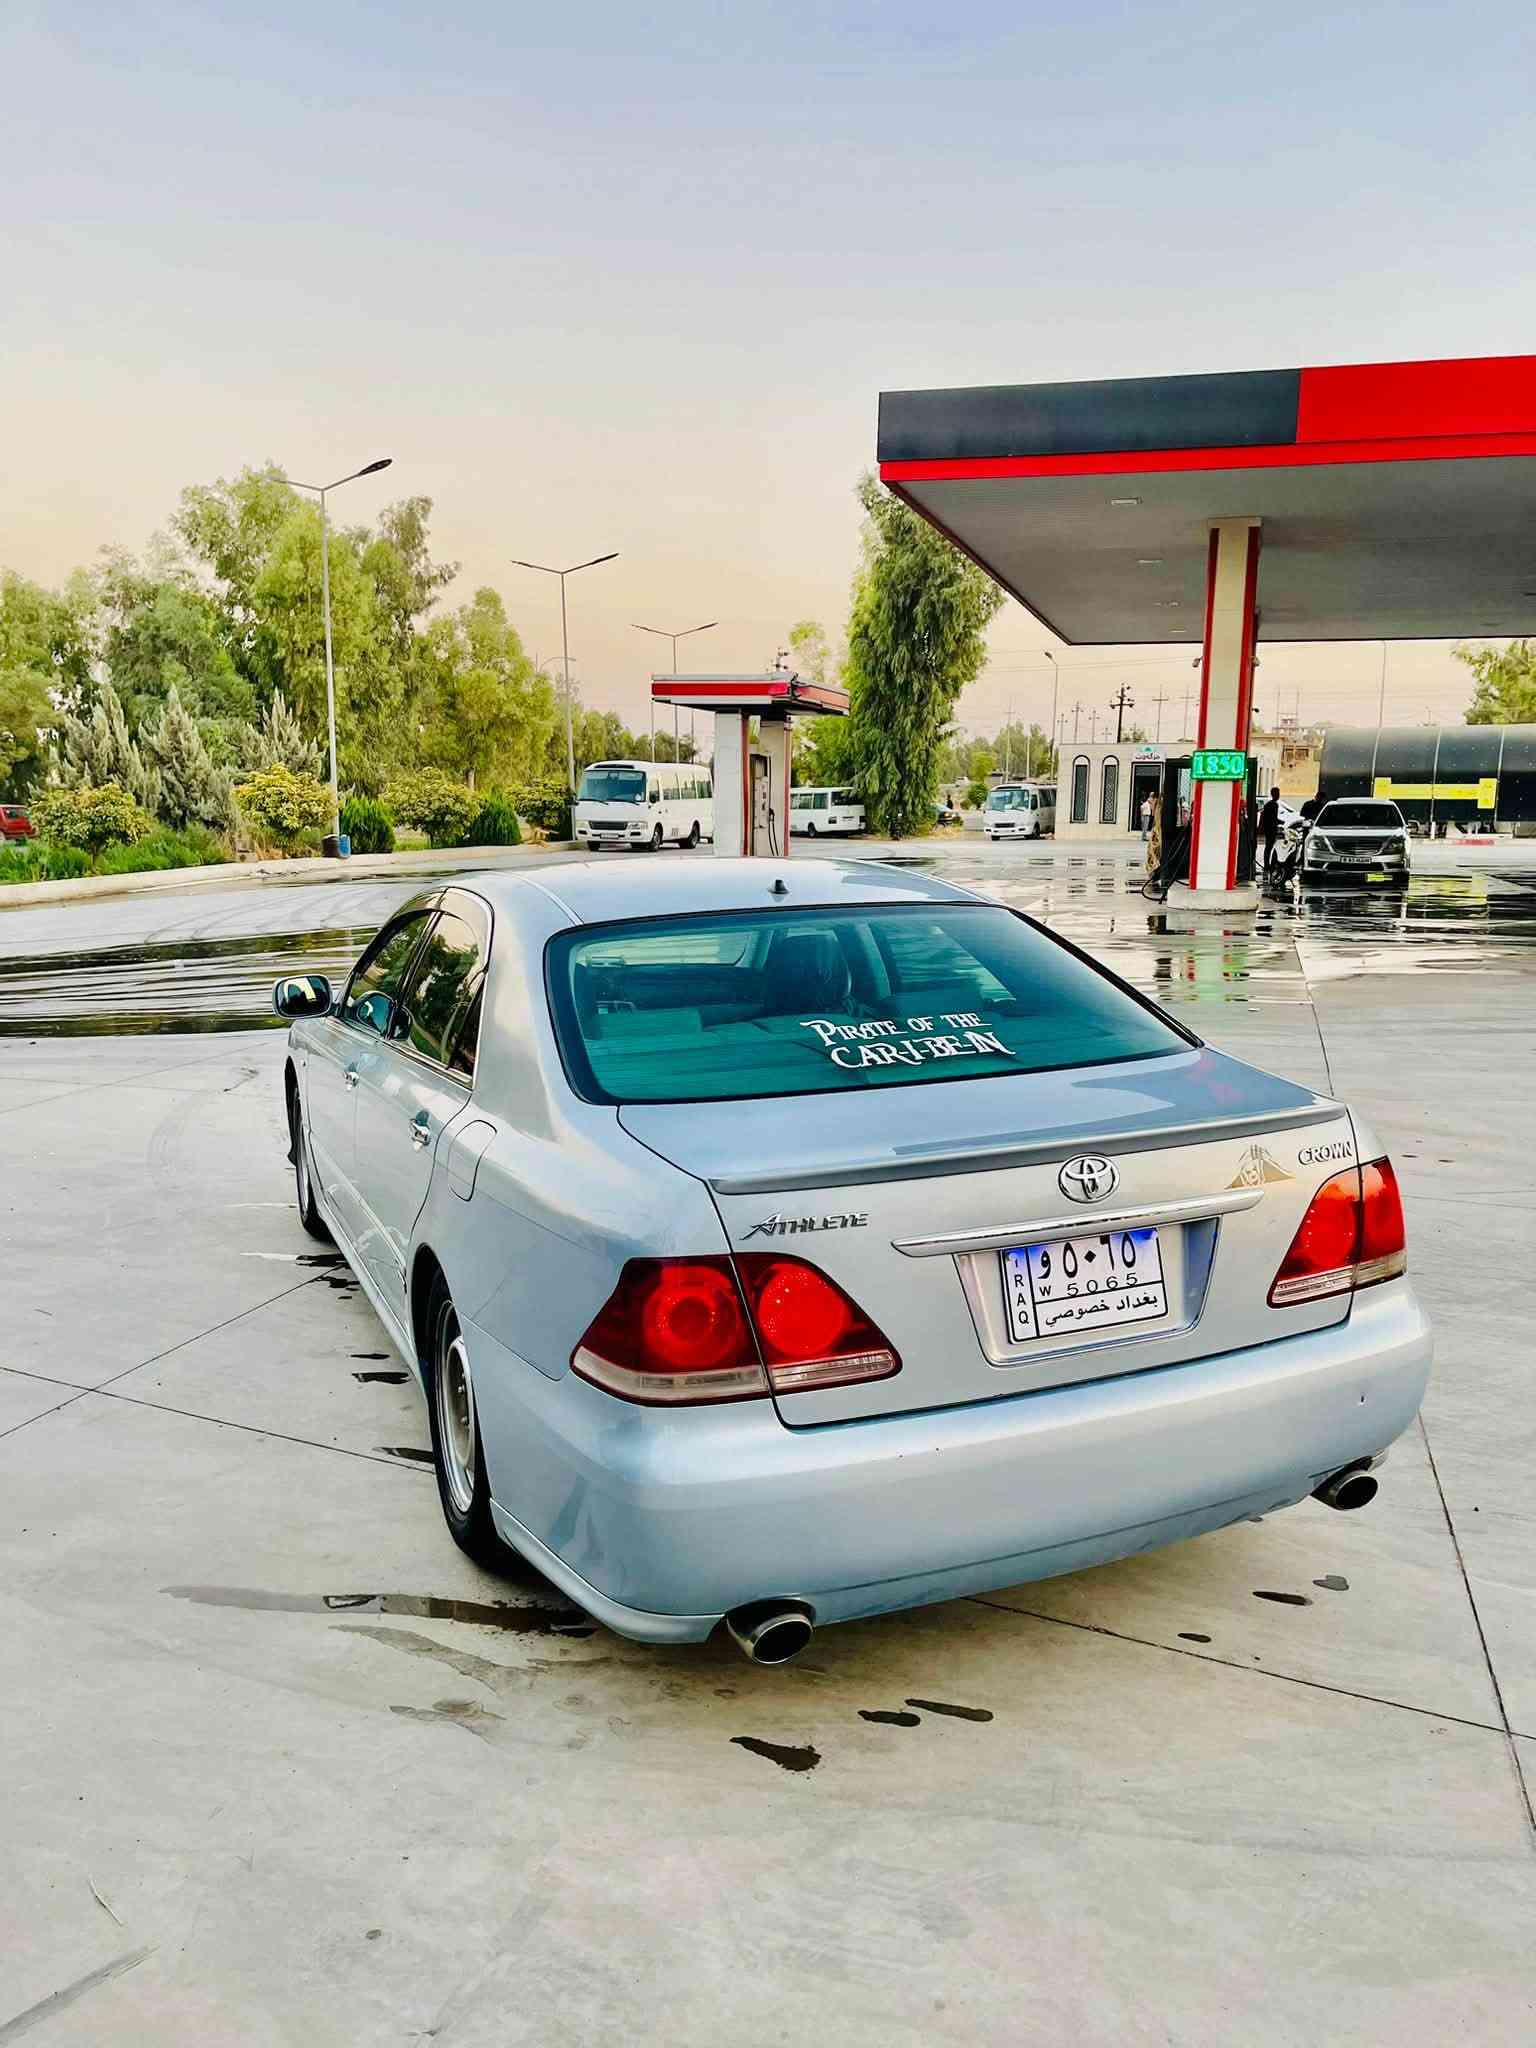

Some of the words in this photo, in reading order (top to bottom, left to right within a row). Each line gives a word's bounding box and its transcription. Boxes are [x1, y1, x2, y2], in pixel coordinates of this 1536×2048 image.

[800, 1019, 908, 1047] PIRATE
[907, 1016, 933, 1032] OF
[940, 1012, 993, 1029] THE
[1297, 1141, 1354, 1166] CROWN
[739, 1212, 870, 1240] ATHLETE
[1039, 1284, 1052, 1297] W
[1066, 1272, 1138, 1297] 5065
[1044, 1301, 1110, 1327] خصوصي
[1115, 1291, 1158, 1313] بغداد
